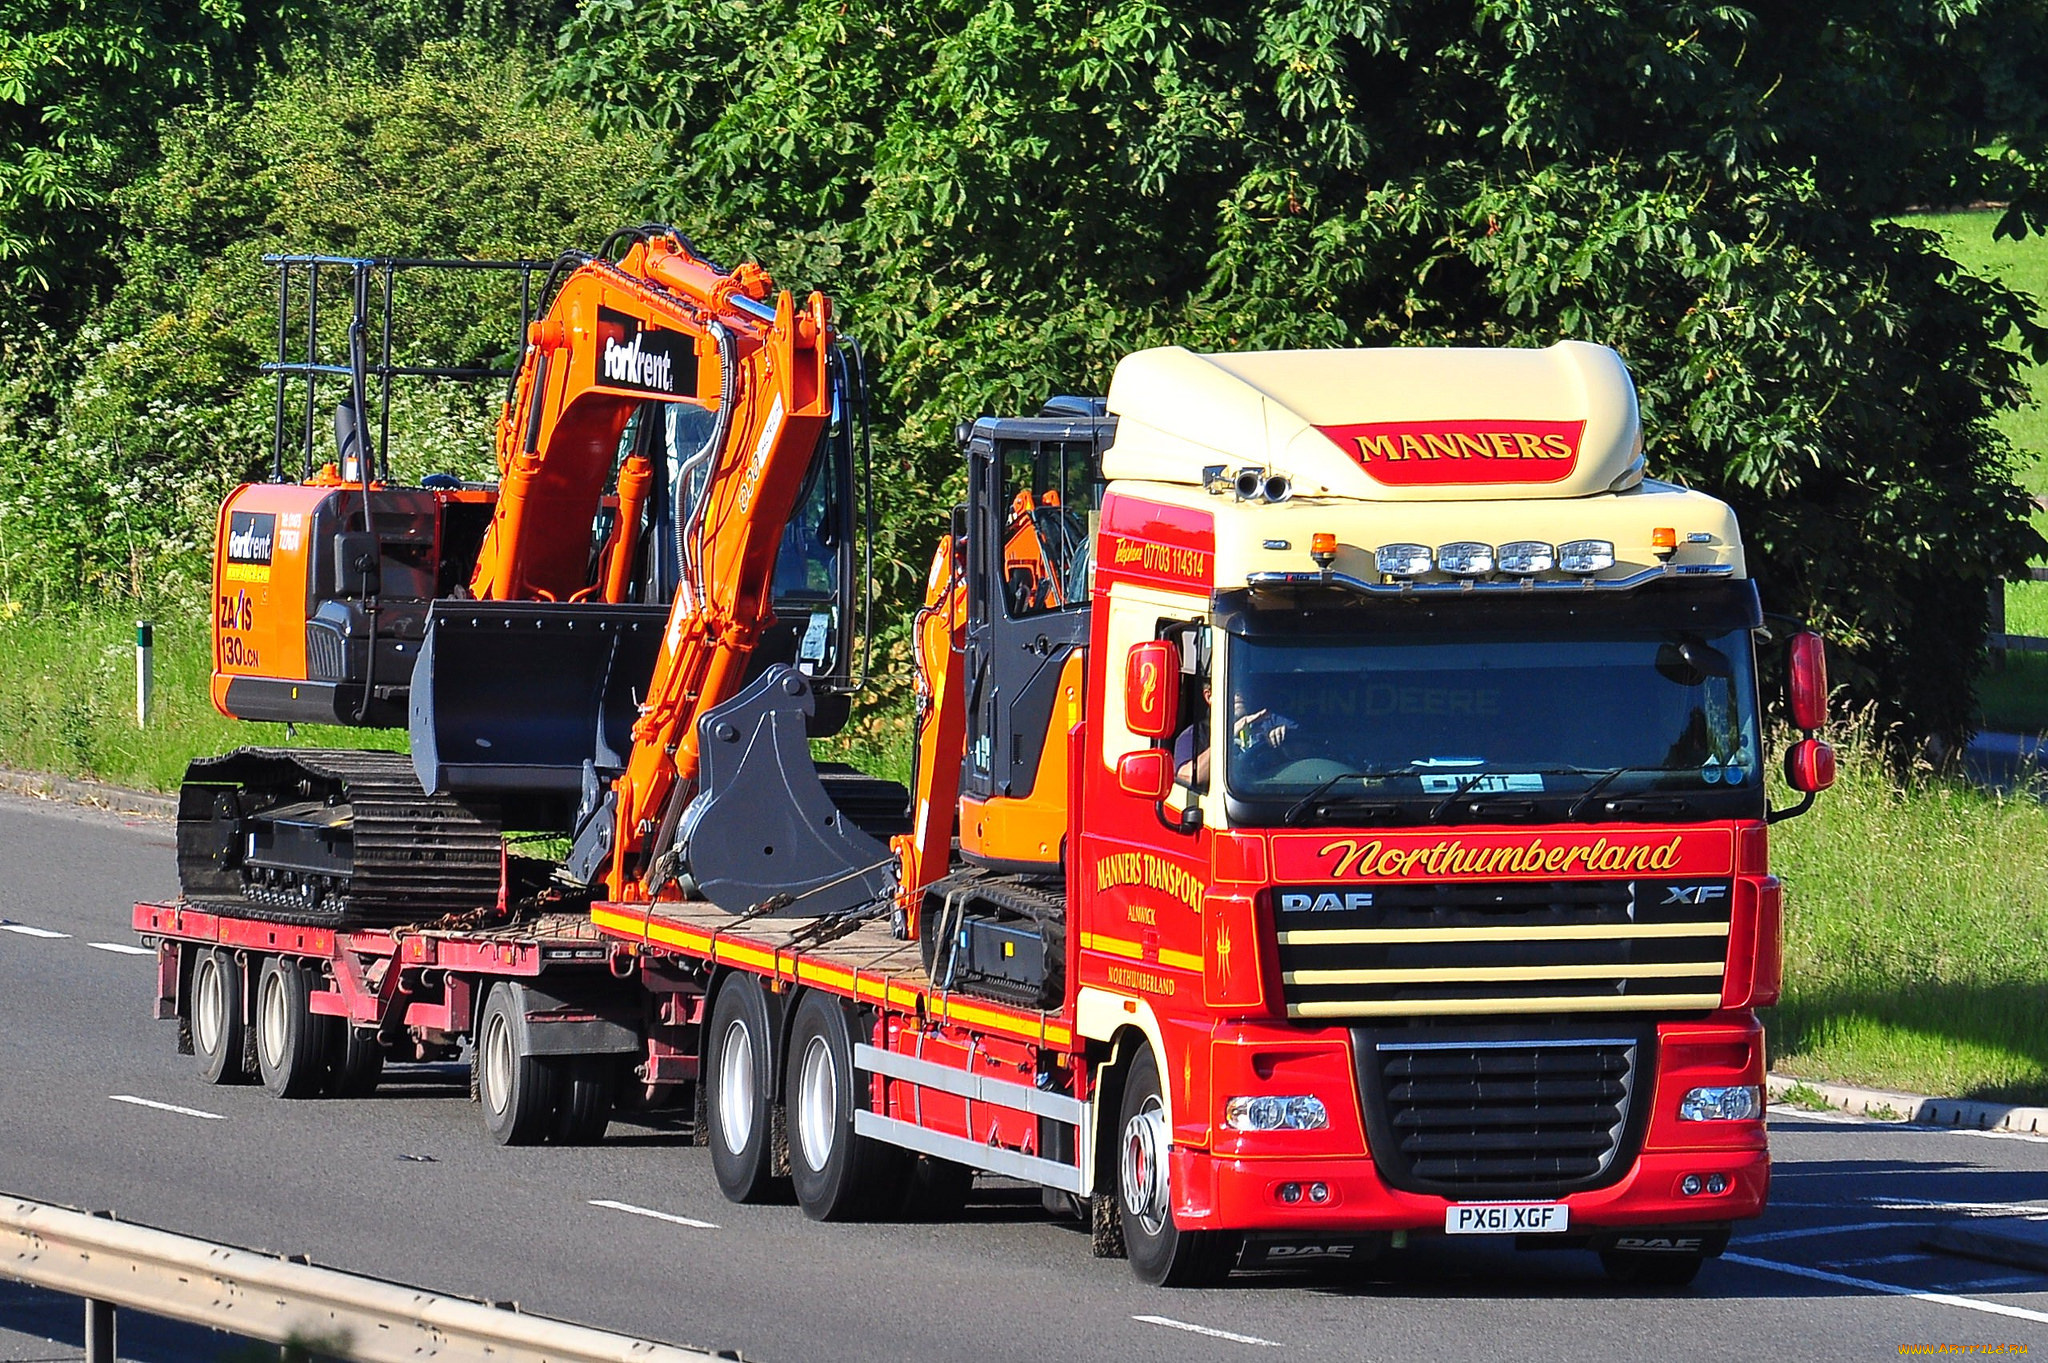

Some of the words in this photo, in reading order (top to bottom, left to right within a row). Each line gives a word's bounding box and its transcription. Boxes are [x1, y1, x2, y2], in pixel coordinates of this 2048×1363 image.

[1353, 433, 1573, 462] MANNERS
[1115, 537, 1144, 567] Telephone
[1143, 542, 1170, 573] 07703
[1172, 550, 1204, 578] 114314
[1318, 835, 1683, 877] Northumberland
[1097, 852, 1142, 893] MANNERS
[1143, 854, 1205, 914] TRANSPORT
[1281, 892, 1374, 912] DAF
[1659, 885, 1728, 905] XF
[1127, 905, 1156, 926] ALNWICK
[1108, 966, 1175, 997] NORTHUMBERLAND
[1460, 1208, 1507, 1229] PX61
[1513, 1207, 1555, 1228] XGF
[1268, 1245, 1355, 1256] DAF
[1616, 1238, 1702, 1248] DAF
